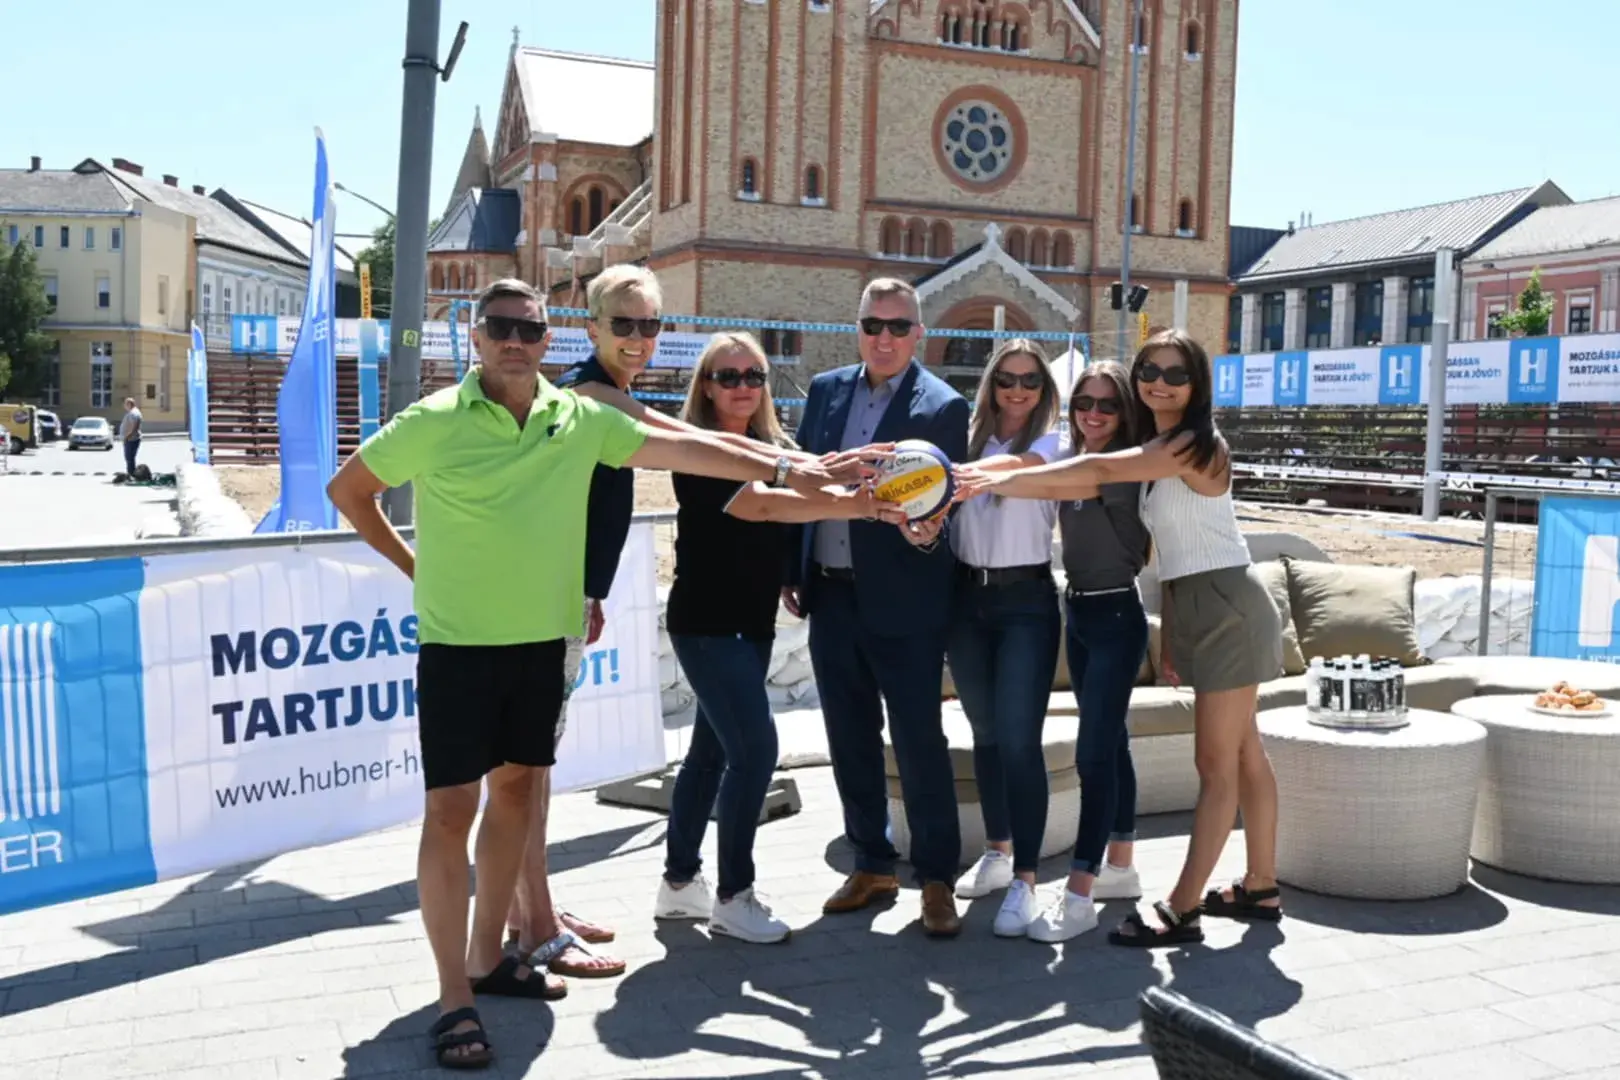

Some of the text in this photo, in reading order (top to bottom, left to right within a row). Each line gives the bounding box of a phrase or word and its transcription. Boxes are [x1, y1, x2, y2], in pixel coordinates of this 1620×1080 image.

[210, 608, 419, 677] MOZGÁS
[216, 749, 418, 808] www.hubner-h
[0, 830, 63, 874] ER
